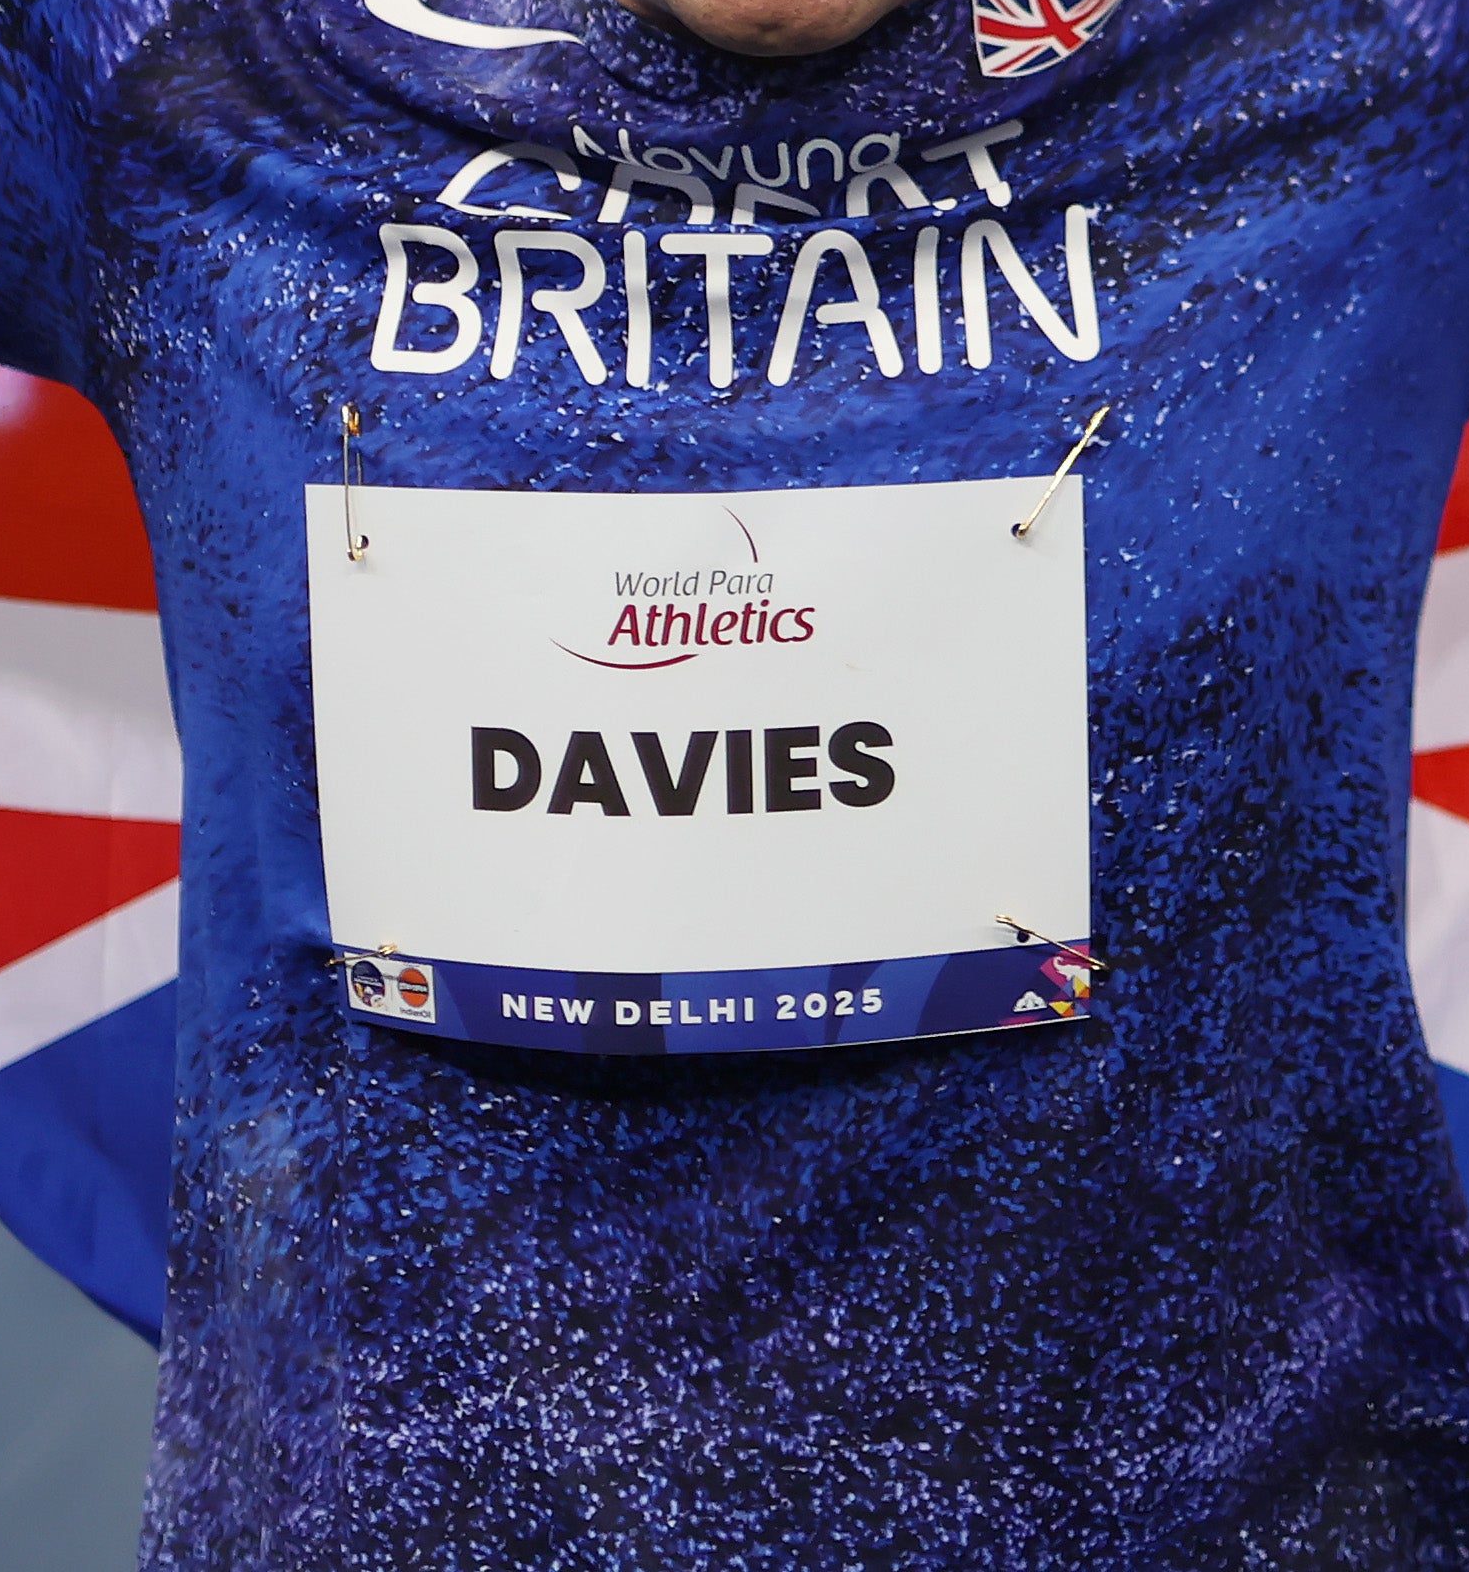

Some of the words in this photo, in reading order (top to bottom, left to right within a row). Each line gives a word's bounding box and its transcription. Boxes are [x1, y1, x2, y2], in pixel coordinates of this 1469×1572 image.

[370, 205, 1101, 389] BRITAIN
[615, 571, 699, 597] World
[709, 570, 773, 595] Para
[607, 599, 815, 646] Athletics
[471, 721, 895, 816] DAVIES
[503, 993, 594, 1024] NEW
[615, 997, 754, 1025] DELHI
[776, 988, 883, 1020] 2025
